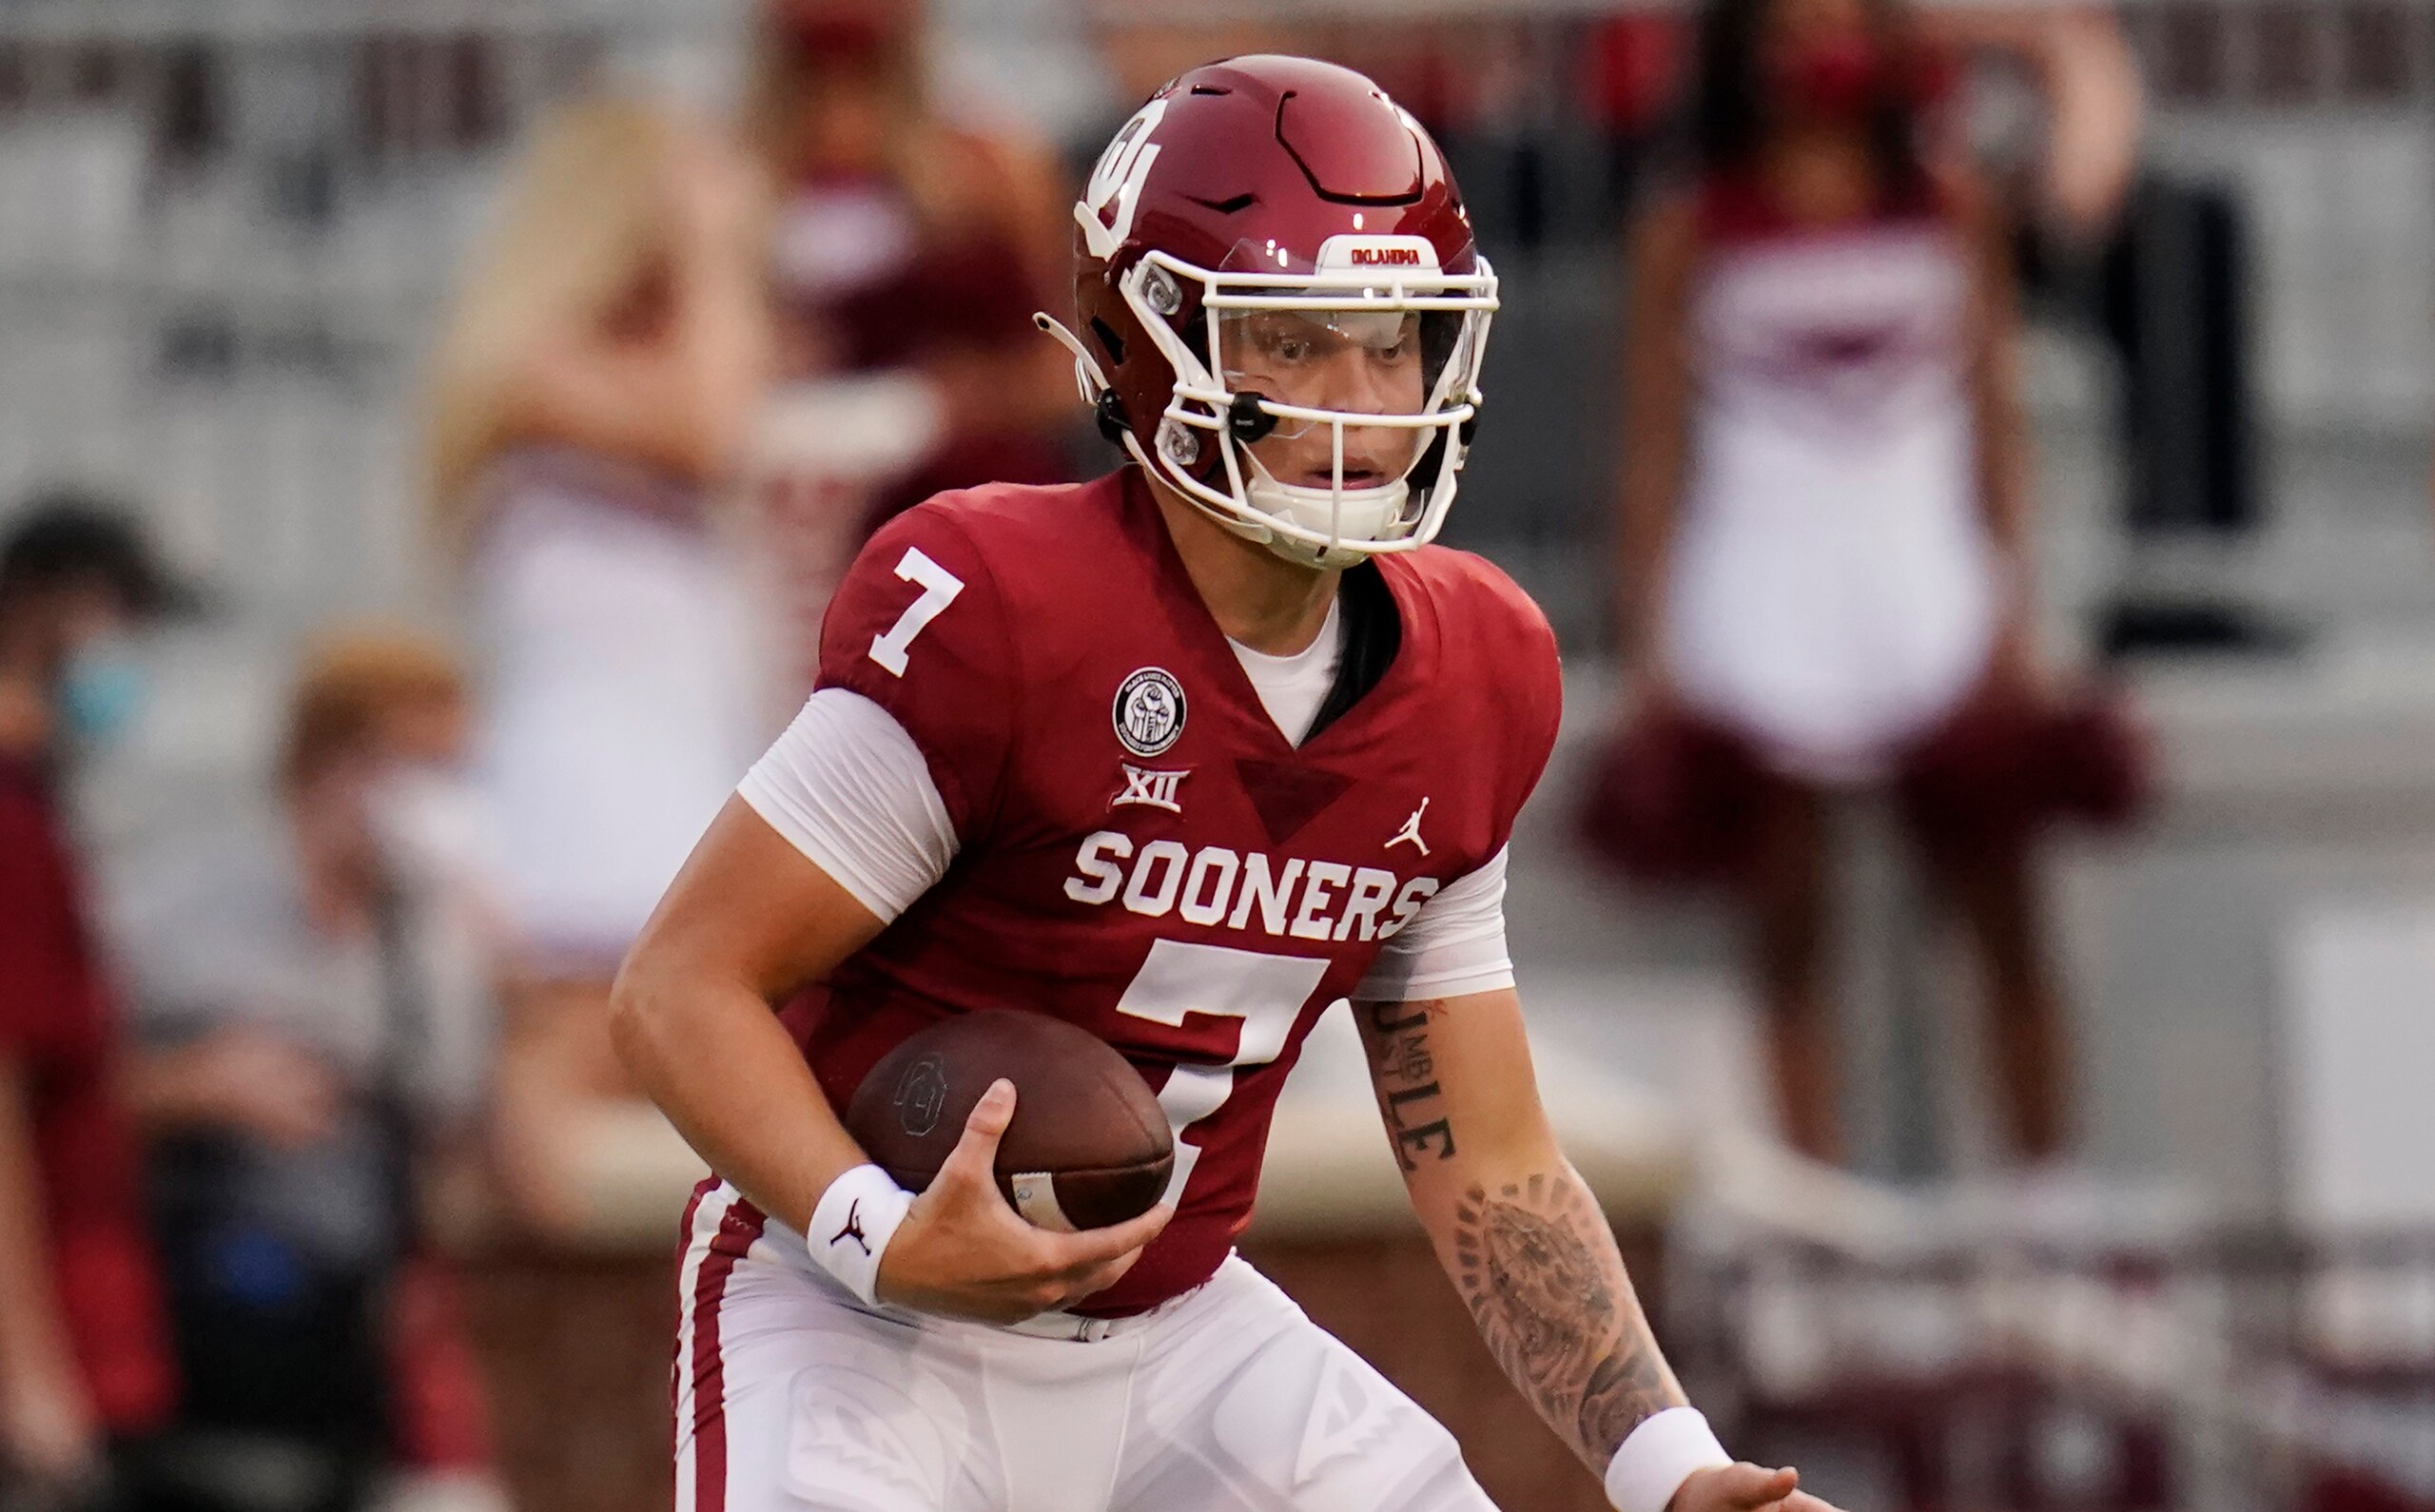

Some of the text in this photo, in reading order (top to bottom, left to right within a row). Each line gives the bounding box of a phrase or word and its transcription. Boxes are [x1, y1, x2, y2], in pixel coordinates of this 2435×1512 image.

[1352, 249, 1420, 265] OKLAHOMA
[868, 545, 965, 679] 7
[1111, 763, 1191, 814] XII
[1063, 830, 1439, 942] SOONERS
[1116, 938, 1332, 1212] 7
